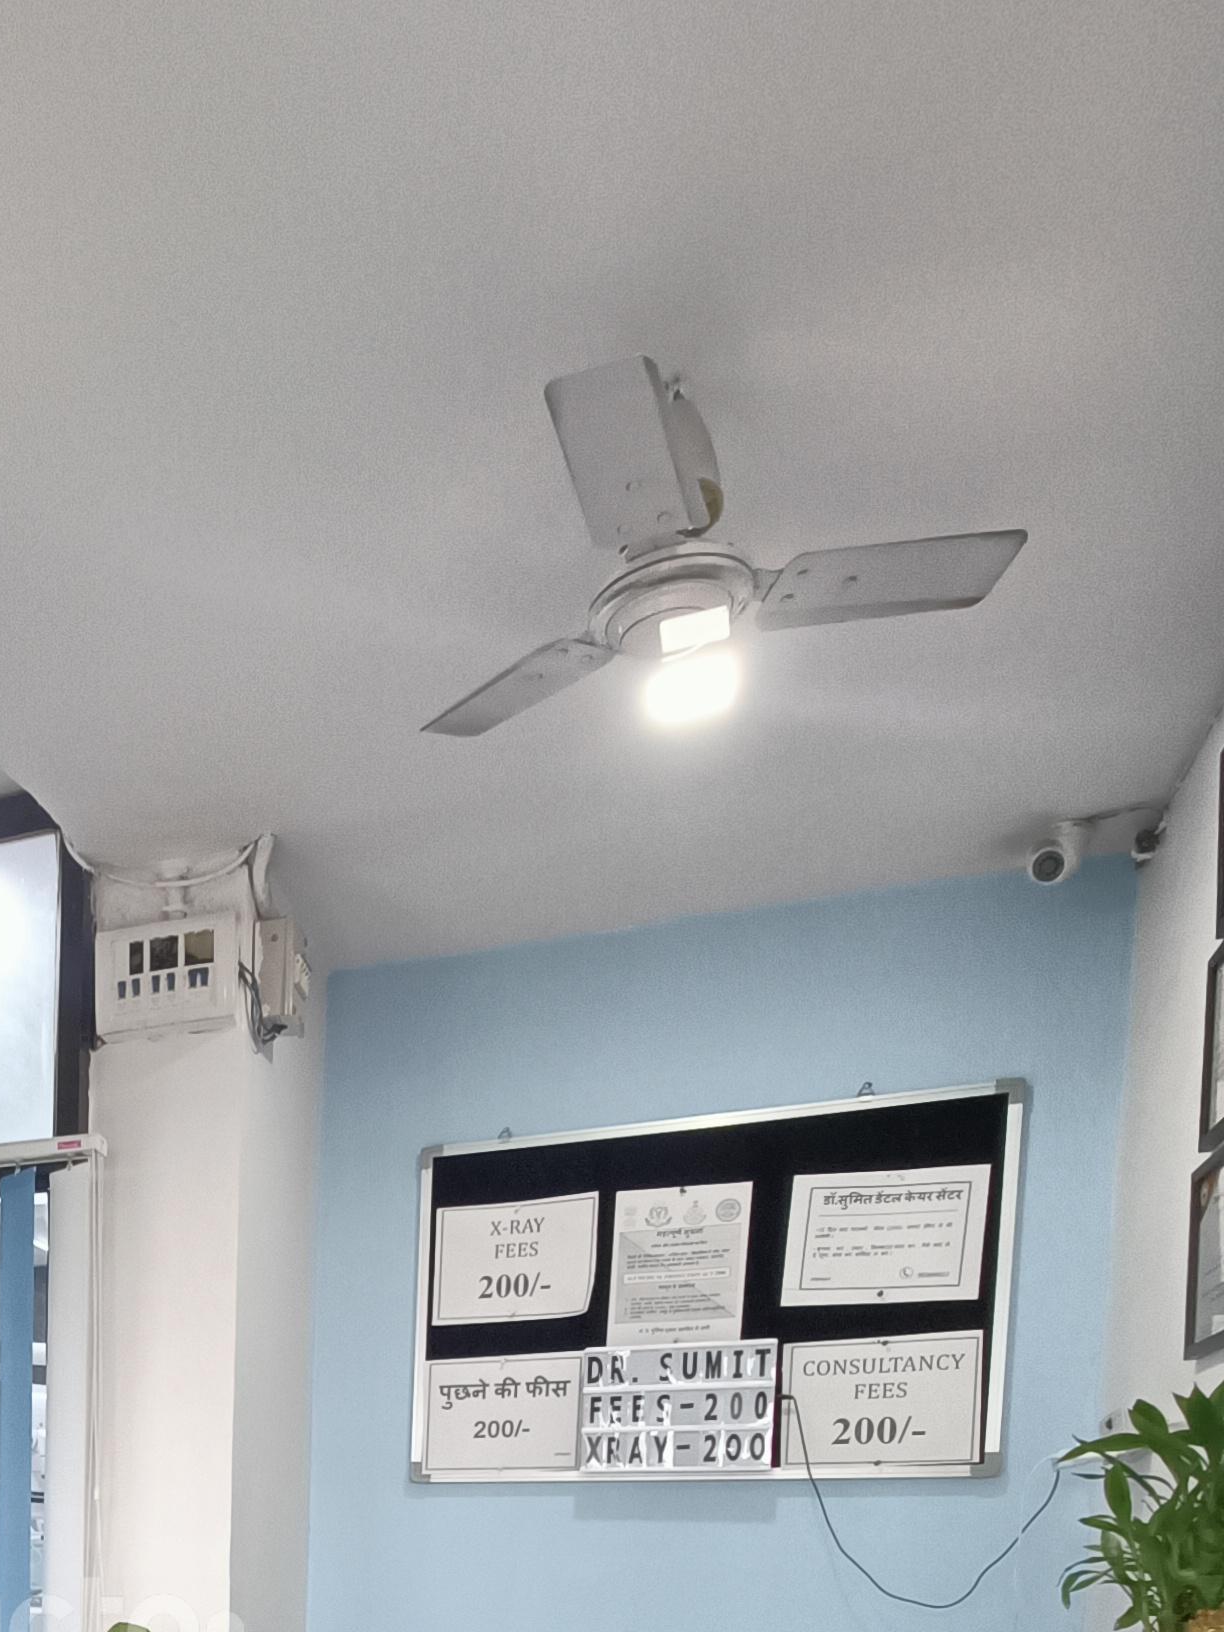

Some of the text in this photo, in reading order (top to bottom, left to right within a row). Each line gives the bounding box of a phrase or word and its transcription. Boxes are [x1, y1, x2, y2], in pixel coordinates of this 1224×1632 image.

[490, 1217, 545, 1236] X-RAY
[494, 1241, 539, 1259] FEES
[478, 1272, 551, 1299] 200/-
[587, 1348, 771, 1384] DR. SUMIT
[802, 1353, 966, 1376] CONSULTANCY
[439, 1375, 571, 1410] पुछने की फीस
[854, 1382, 908, 1400] FEES
[473, 1419, 530, 1439] 200/-
[831, 1415, 926, 1445] 200/-
